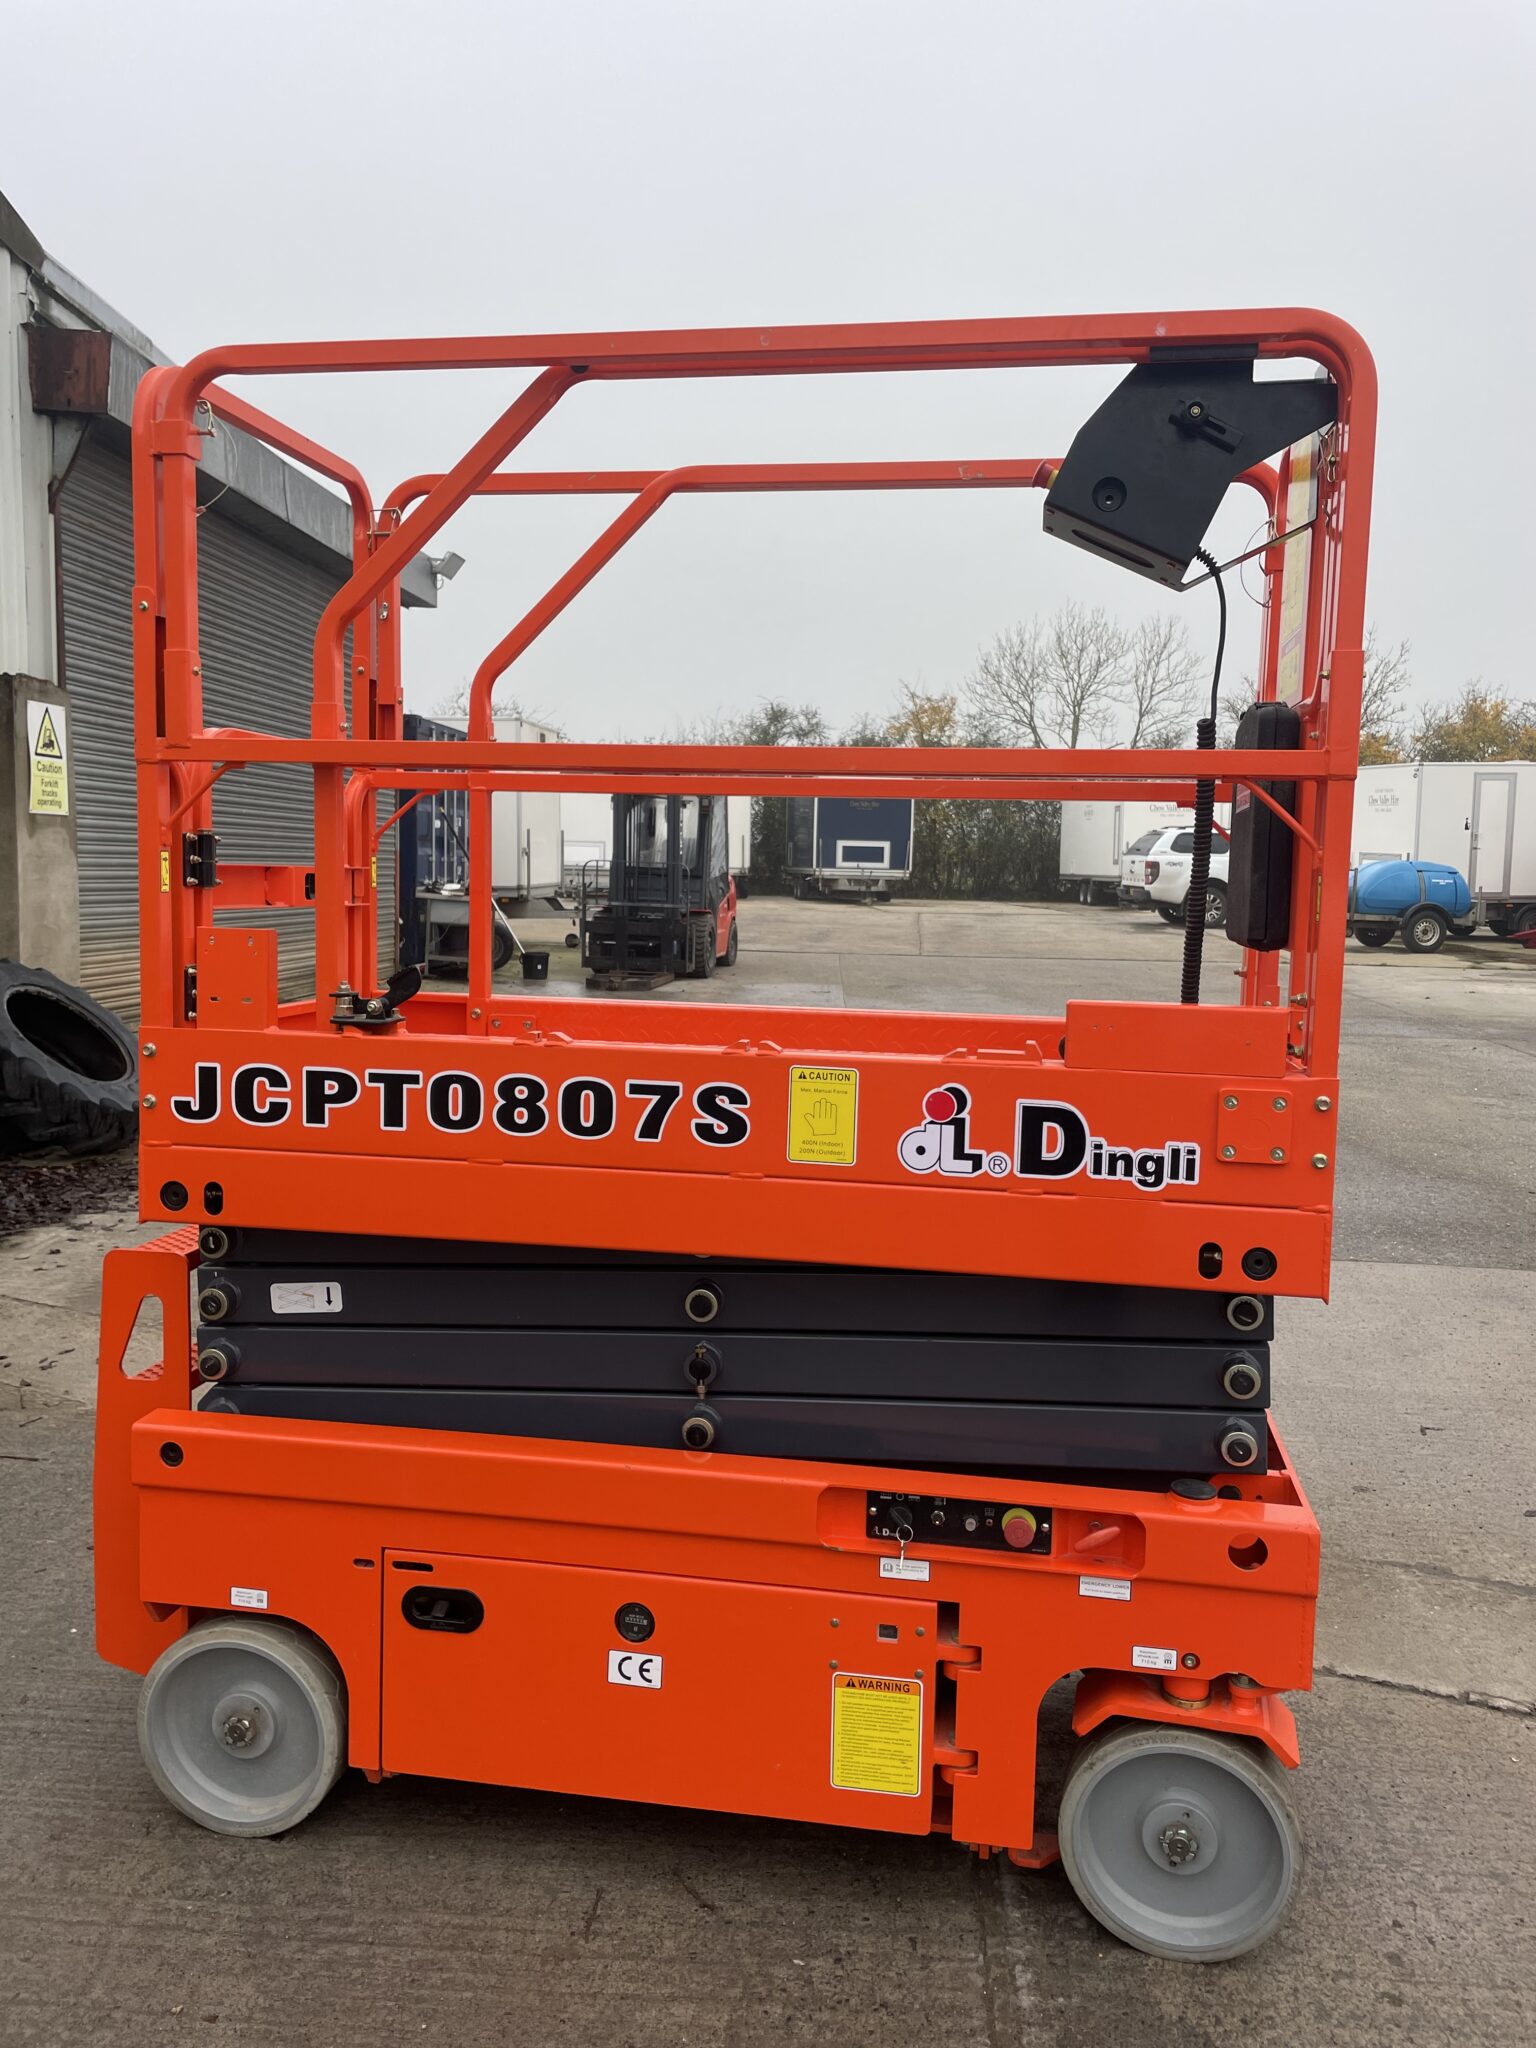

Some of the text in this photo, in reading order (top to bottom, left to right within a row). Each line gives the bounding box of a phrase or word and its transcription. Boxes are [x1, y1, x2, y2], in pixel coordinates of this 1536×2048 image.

[36, 761, 63, 775] Caution
[41, 789, 58, 797] trucks
[37, 799, 62, 809] operating
[808, 1071, 851, 1082] CAUTION
[171, 1062, 751, 1147] JCPT0807S
[1014, 1098, 1200, 1191] Dingli
[617, 1656, 654, 1684] CE
[858, 1679, 910, 1693] WARNING
